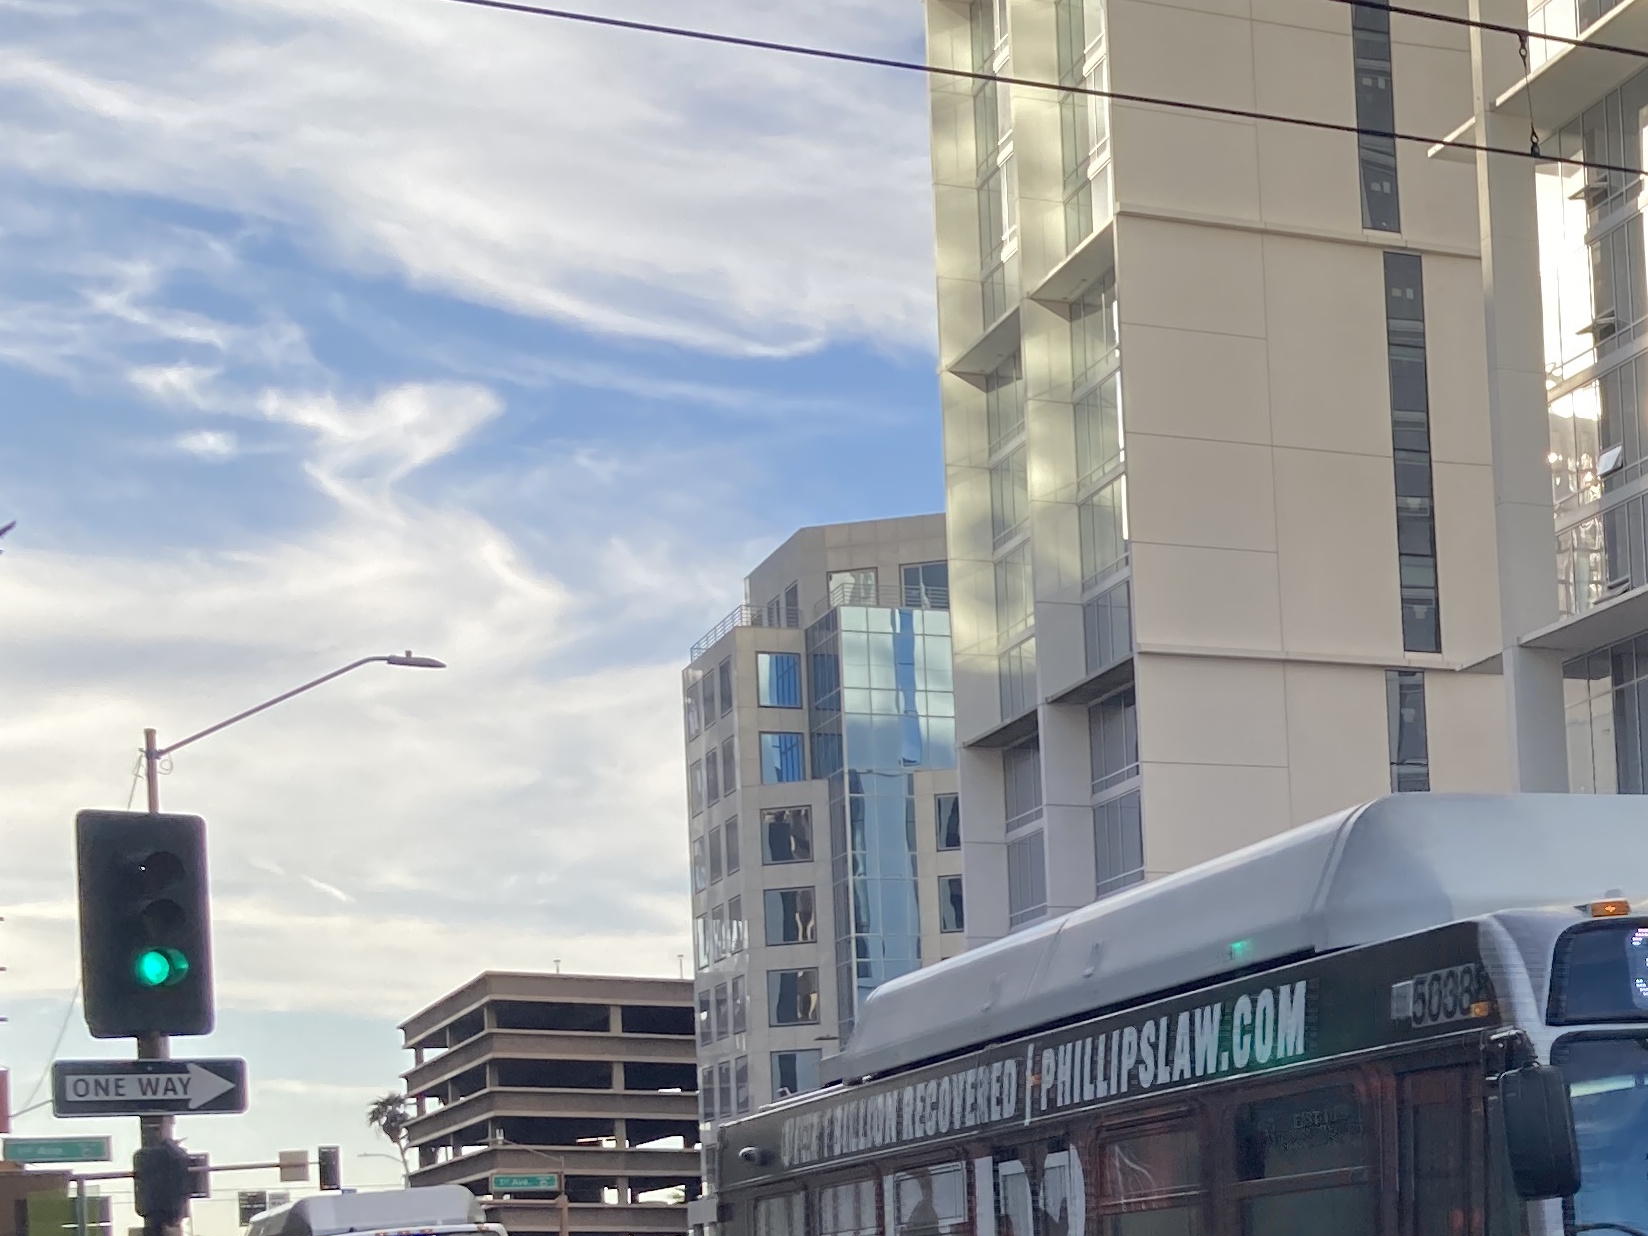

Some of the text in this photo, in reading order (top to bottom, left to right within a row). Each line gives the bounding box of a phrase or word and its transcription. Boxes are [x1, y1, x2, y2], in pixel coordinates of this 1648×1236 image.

[1411, 964, 1475, 1026] 5038
[1040, 980, 1308, 1111] PHILLIPSLAW.COM
[73, 1076, 191, 1098] ONE WAY
[902, 1058, 1017, 1140] RECOVERED
